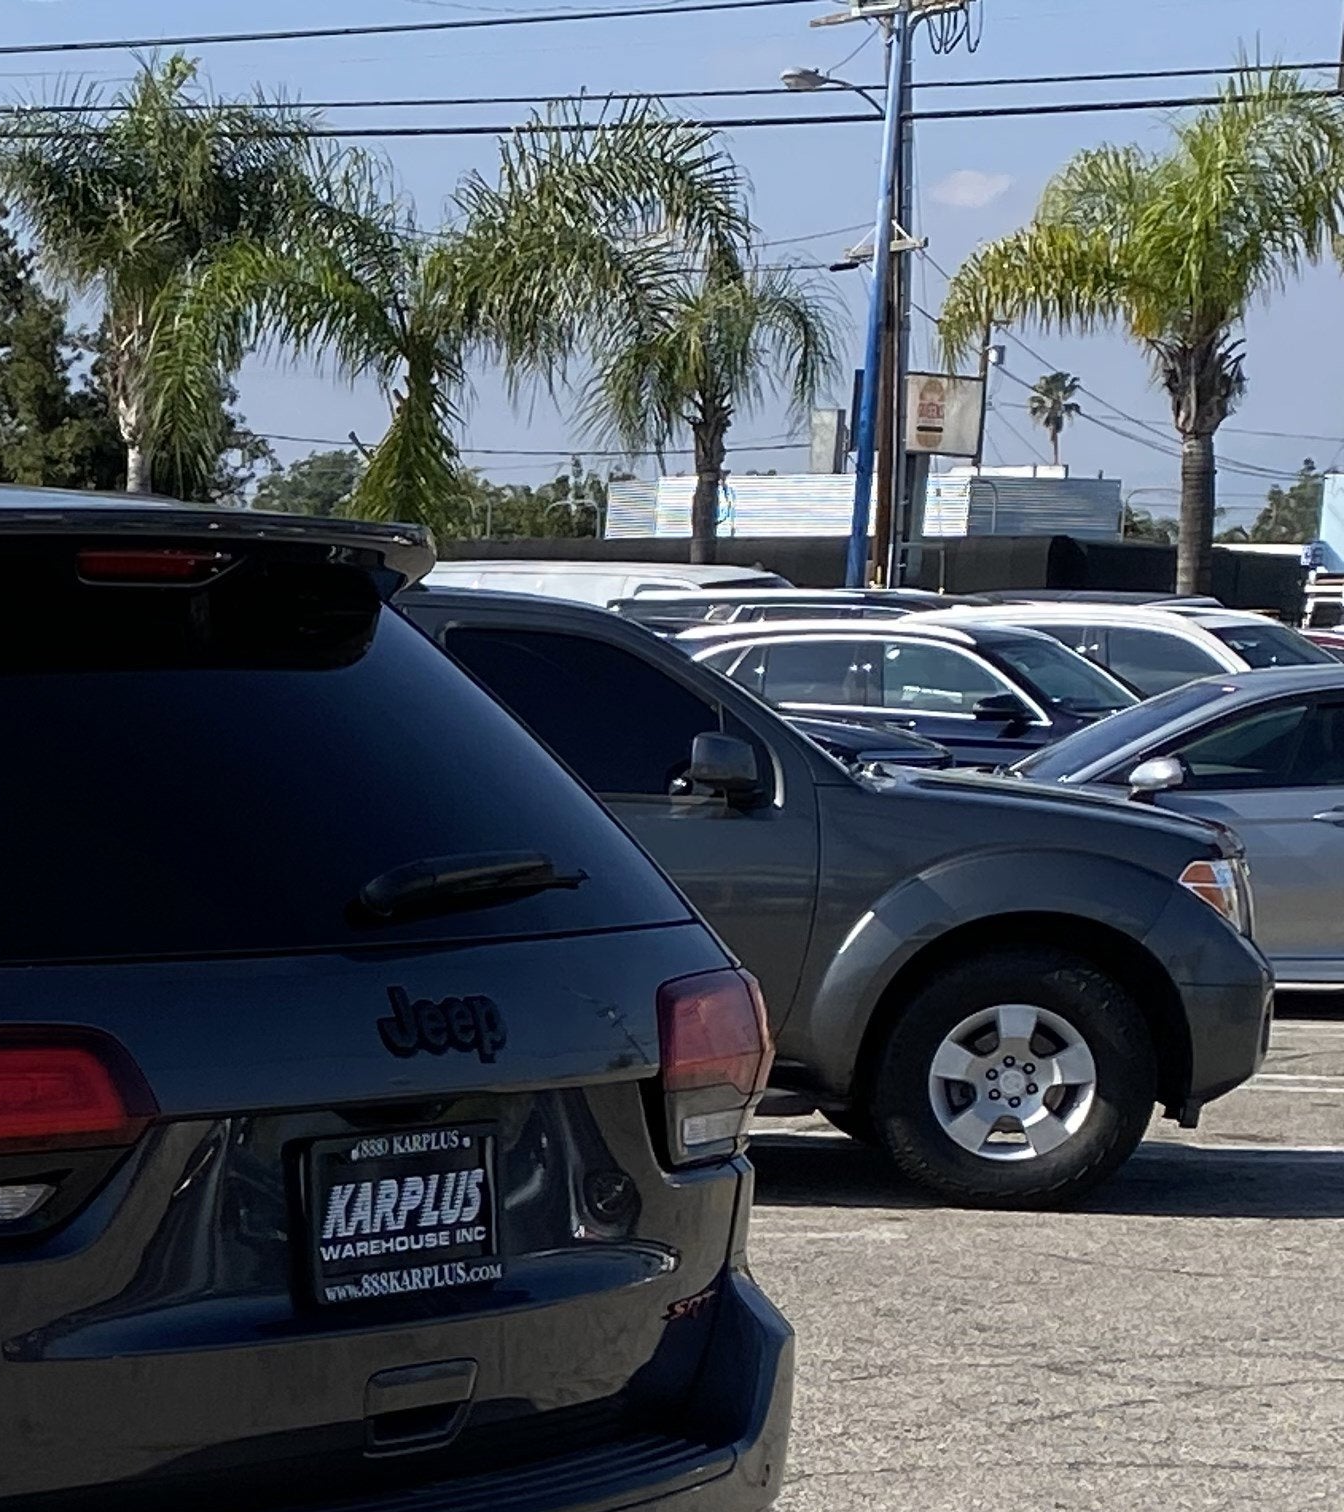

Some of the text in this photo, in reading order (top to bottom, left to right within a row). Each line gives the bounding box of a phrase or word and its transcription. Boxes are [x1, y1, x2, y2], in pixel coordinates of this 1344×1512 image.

[377, 986, 507, 1064] Jeep
[392, 1130, 460, 1155] KARPLUS
[322, 1168, 485, 1239] KARPLUS
[320, 1226, 486, 1261] WAREHOUSE INC
